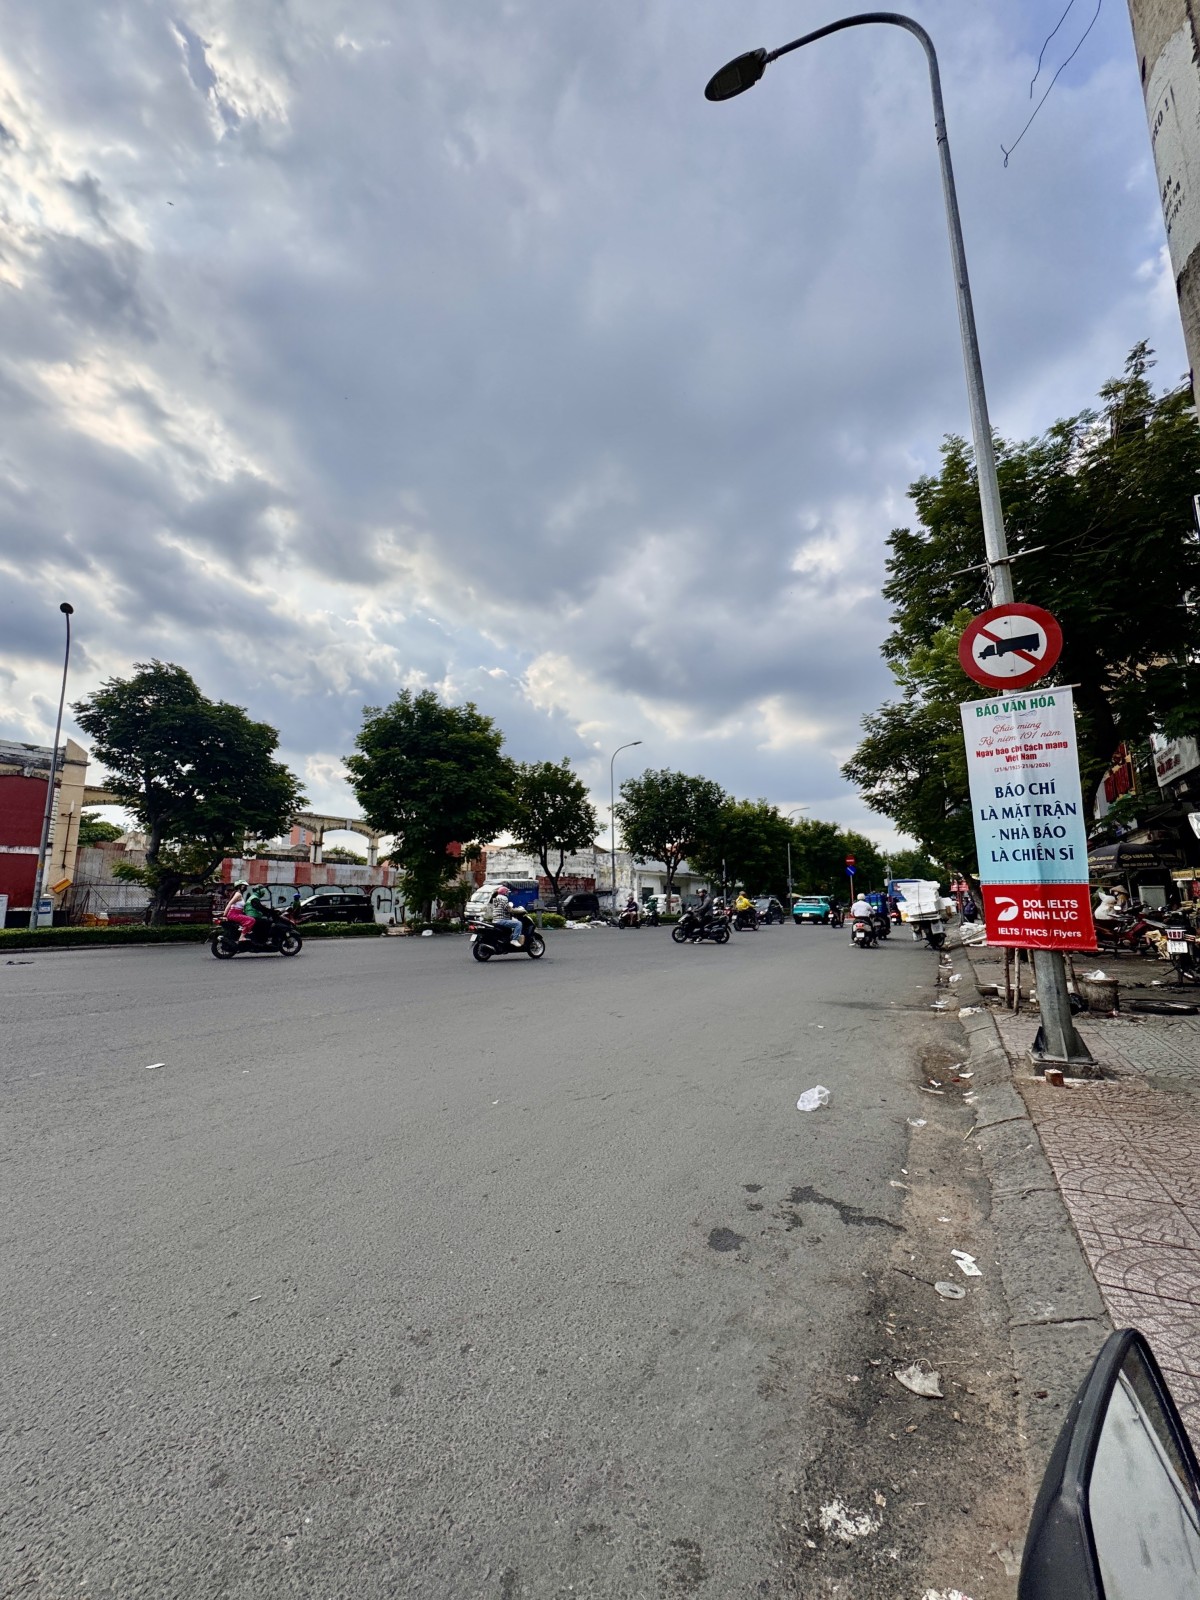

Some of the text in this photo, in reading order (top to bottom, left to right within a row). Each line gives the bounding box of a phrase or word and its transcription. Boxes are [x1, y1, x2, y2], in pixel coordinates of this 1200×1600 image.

[976, 695, 1056, 717] BÁO VĂN HÓA
[1019, 731, 1038, 740] 101
[1024, 743, 1043, 752] Cách
[1045, 741, 1068, 751] mạng
[994, 778, 1056, 799] BÁO CHÍ
[980, 800, 1077, 821] LÀ MẶT TRẬN
[999, 824, 1029, 841] NHÀ
[1033, 823, 1066, 839] BÁO
[991, 842, 1074, 862] LÀ CHIẾN SĨ
[1022, 899, 1079, 909] DOL IELTS
[1023, 908, 1079, 922] ĐÌNH LỰC
[997, 927, 1020, 935] IELTS
[1024, 928, 1048, 937] THCS
[1053, 929, 1082, 938] Flyers
